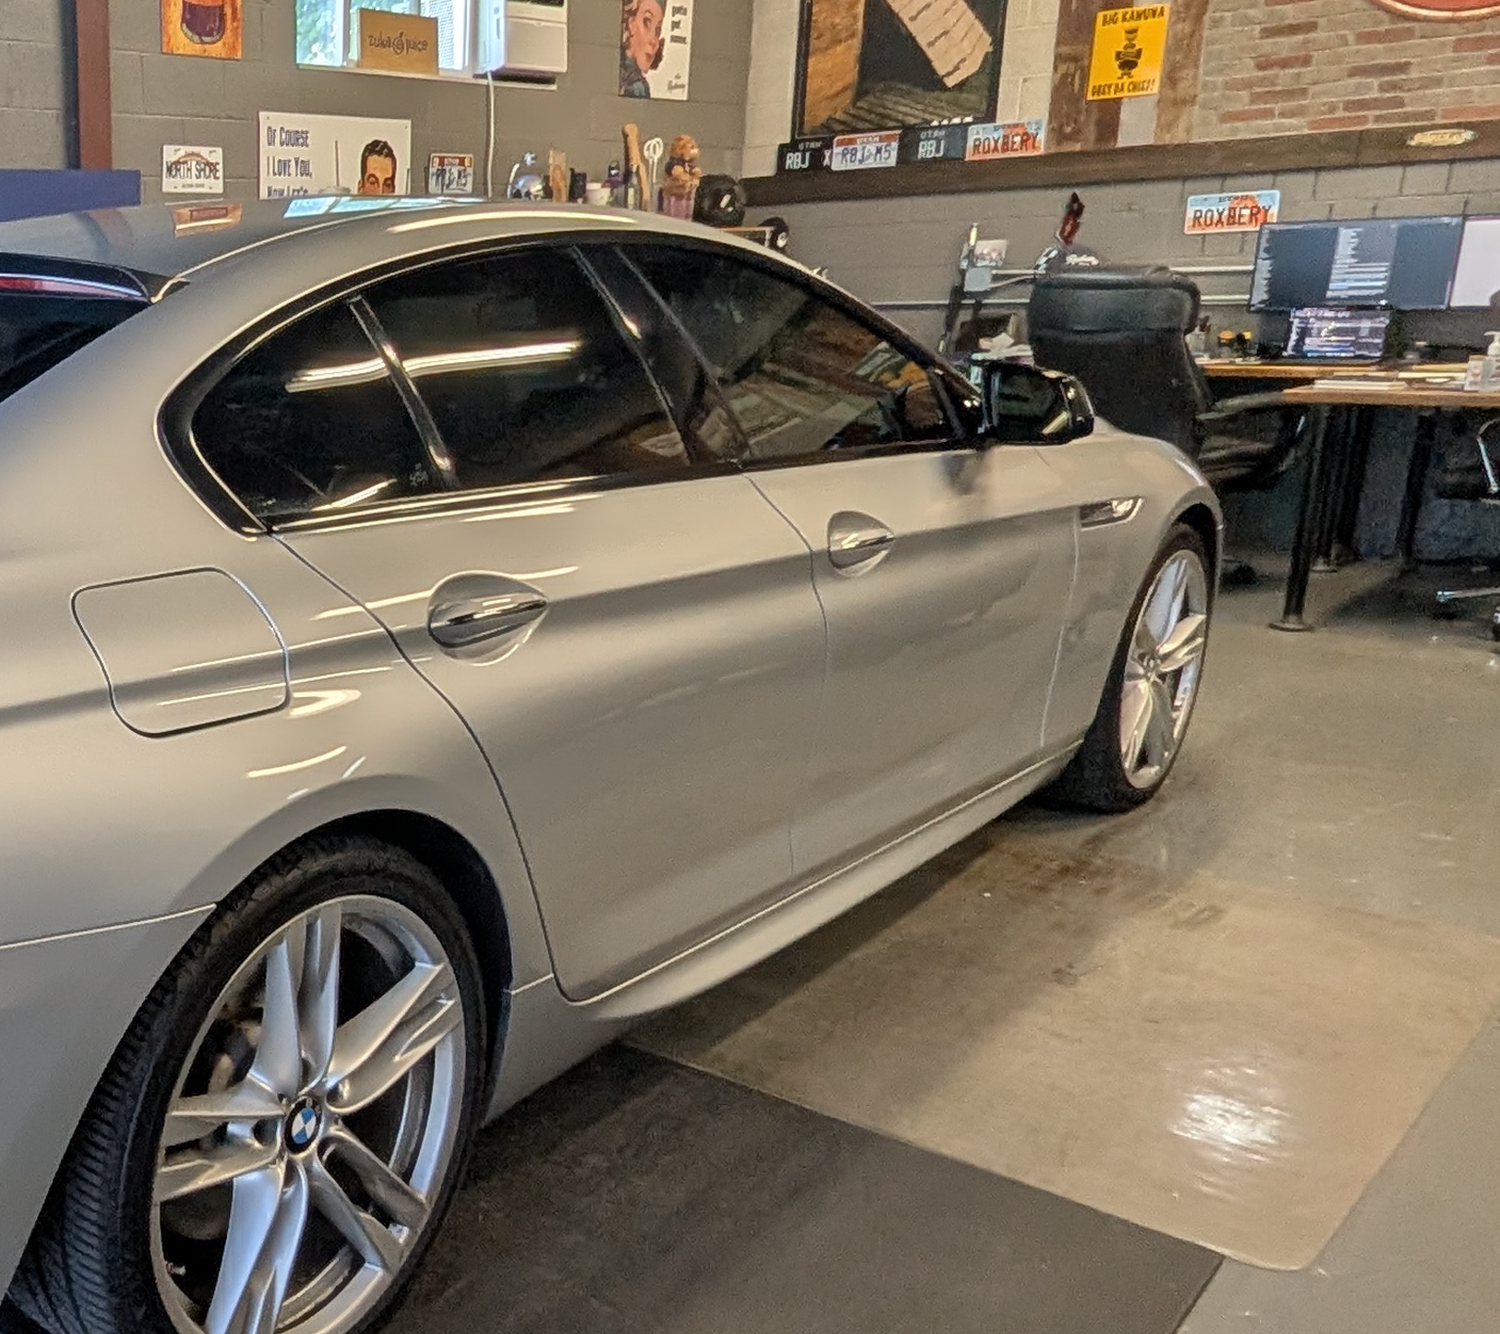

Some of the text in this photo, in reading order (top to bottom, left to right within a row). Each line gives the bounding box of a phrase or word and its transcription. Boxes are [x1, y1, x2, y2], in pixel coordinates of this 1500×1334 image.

[1102, 12, 1118, 27] BIG
[918, 139, 945, 159] RBJ
[972, 131, 1040, 156] ROXBERY
[786, 151, 811, 169] RBJ
[165, 161, 220, 180] NORTH SHORE
[1192, 204, 1272, 227] ROXBERY
